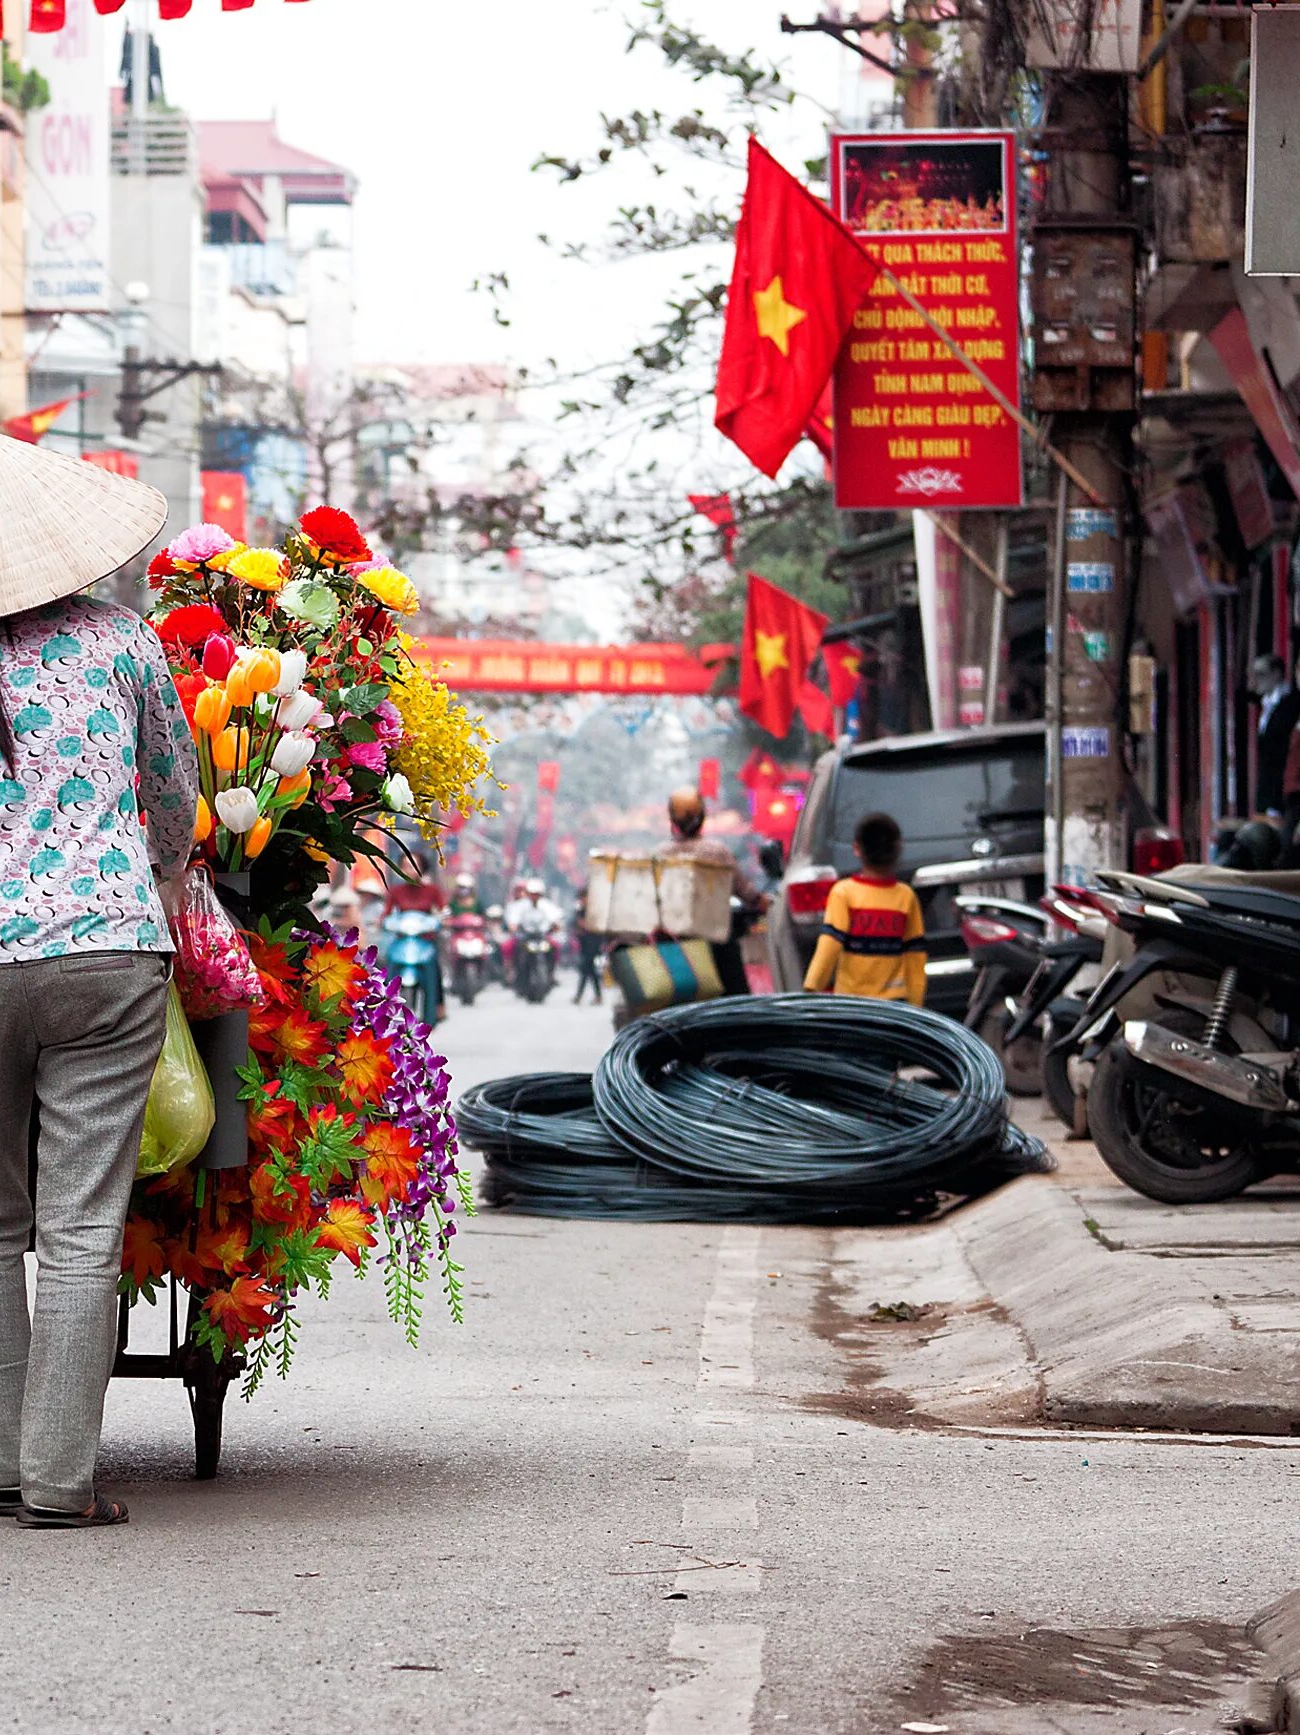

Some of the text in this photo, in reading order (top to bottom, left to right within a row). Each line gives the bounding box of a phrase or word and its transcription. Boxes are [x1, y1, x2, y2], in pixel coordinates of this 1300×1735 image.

[883, 243, 913, 265] QUA
[915, 239, 962, 263] THÁCH
[930, 271, 962, 296] THỜI
[854, 302, 882, 329] CHỦ
[851, 335, 895, 363] QUYẾT
[898, 338, 929, 360] TÂM
[874, 367, 907, 393] TỈNH
[910, 374, 944, 393] NAM
[851, 404, 890, 427] NGÀY
[893, 403, 933, 426] CÀNG
[921, 438, 960, 458] MINH
